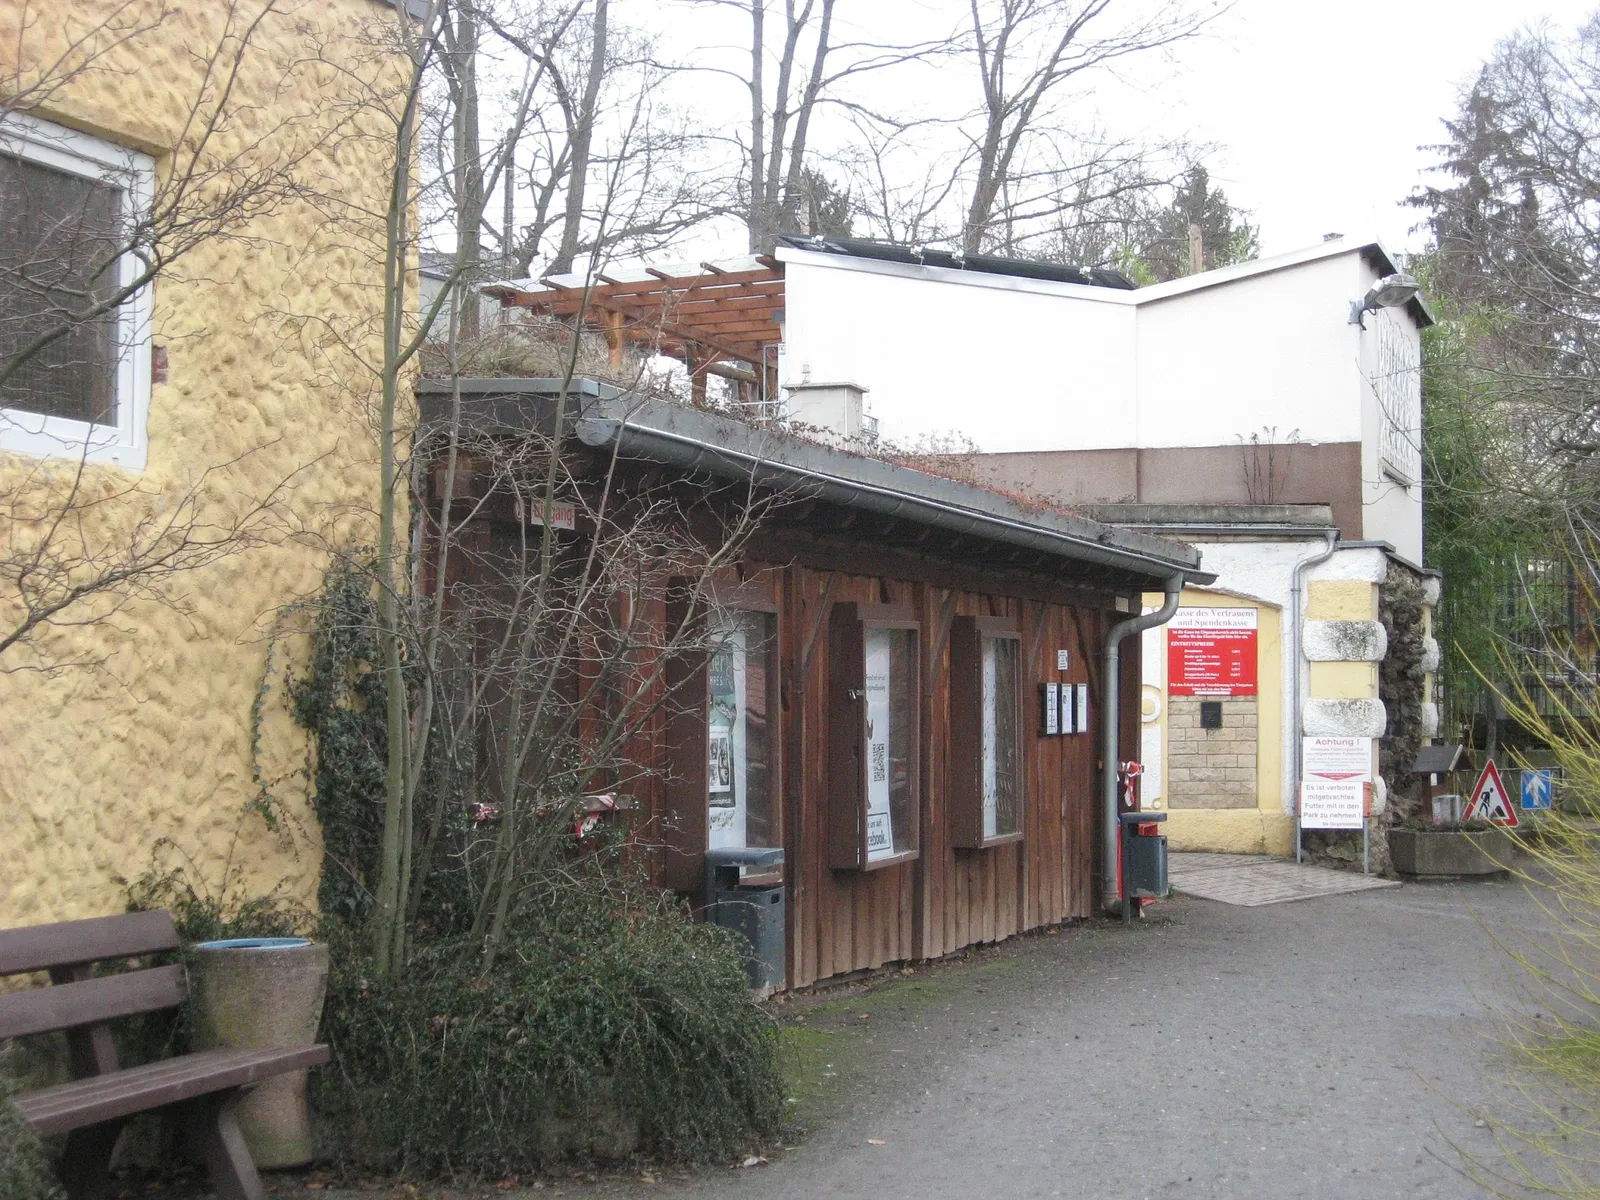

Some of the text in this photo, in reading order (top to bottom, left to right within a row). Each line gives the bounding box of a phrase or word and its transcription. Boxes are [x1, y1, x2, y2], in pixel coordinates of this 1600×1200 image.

[535, 499, 572, 526] Eigang
[1196, 609, 1209, 617] des
[1210, 609, 1255, 617] Vertrauens
[1194, 619, 1249, 627] Spendenkasse
[1315, 738, 1354, 746] Achtung
